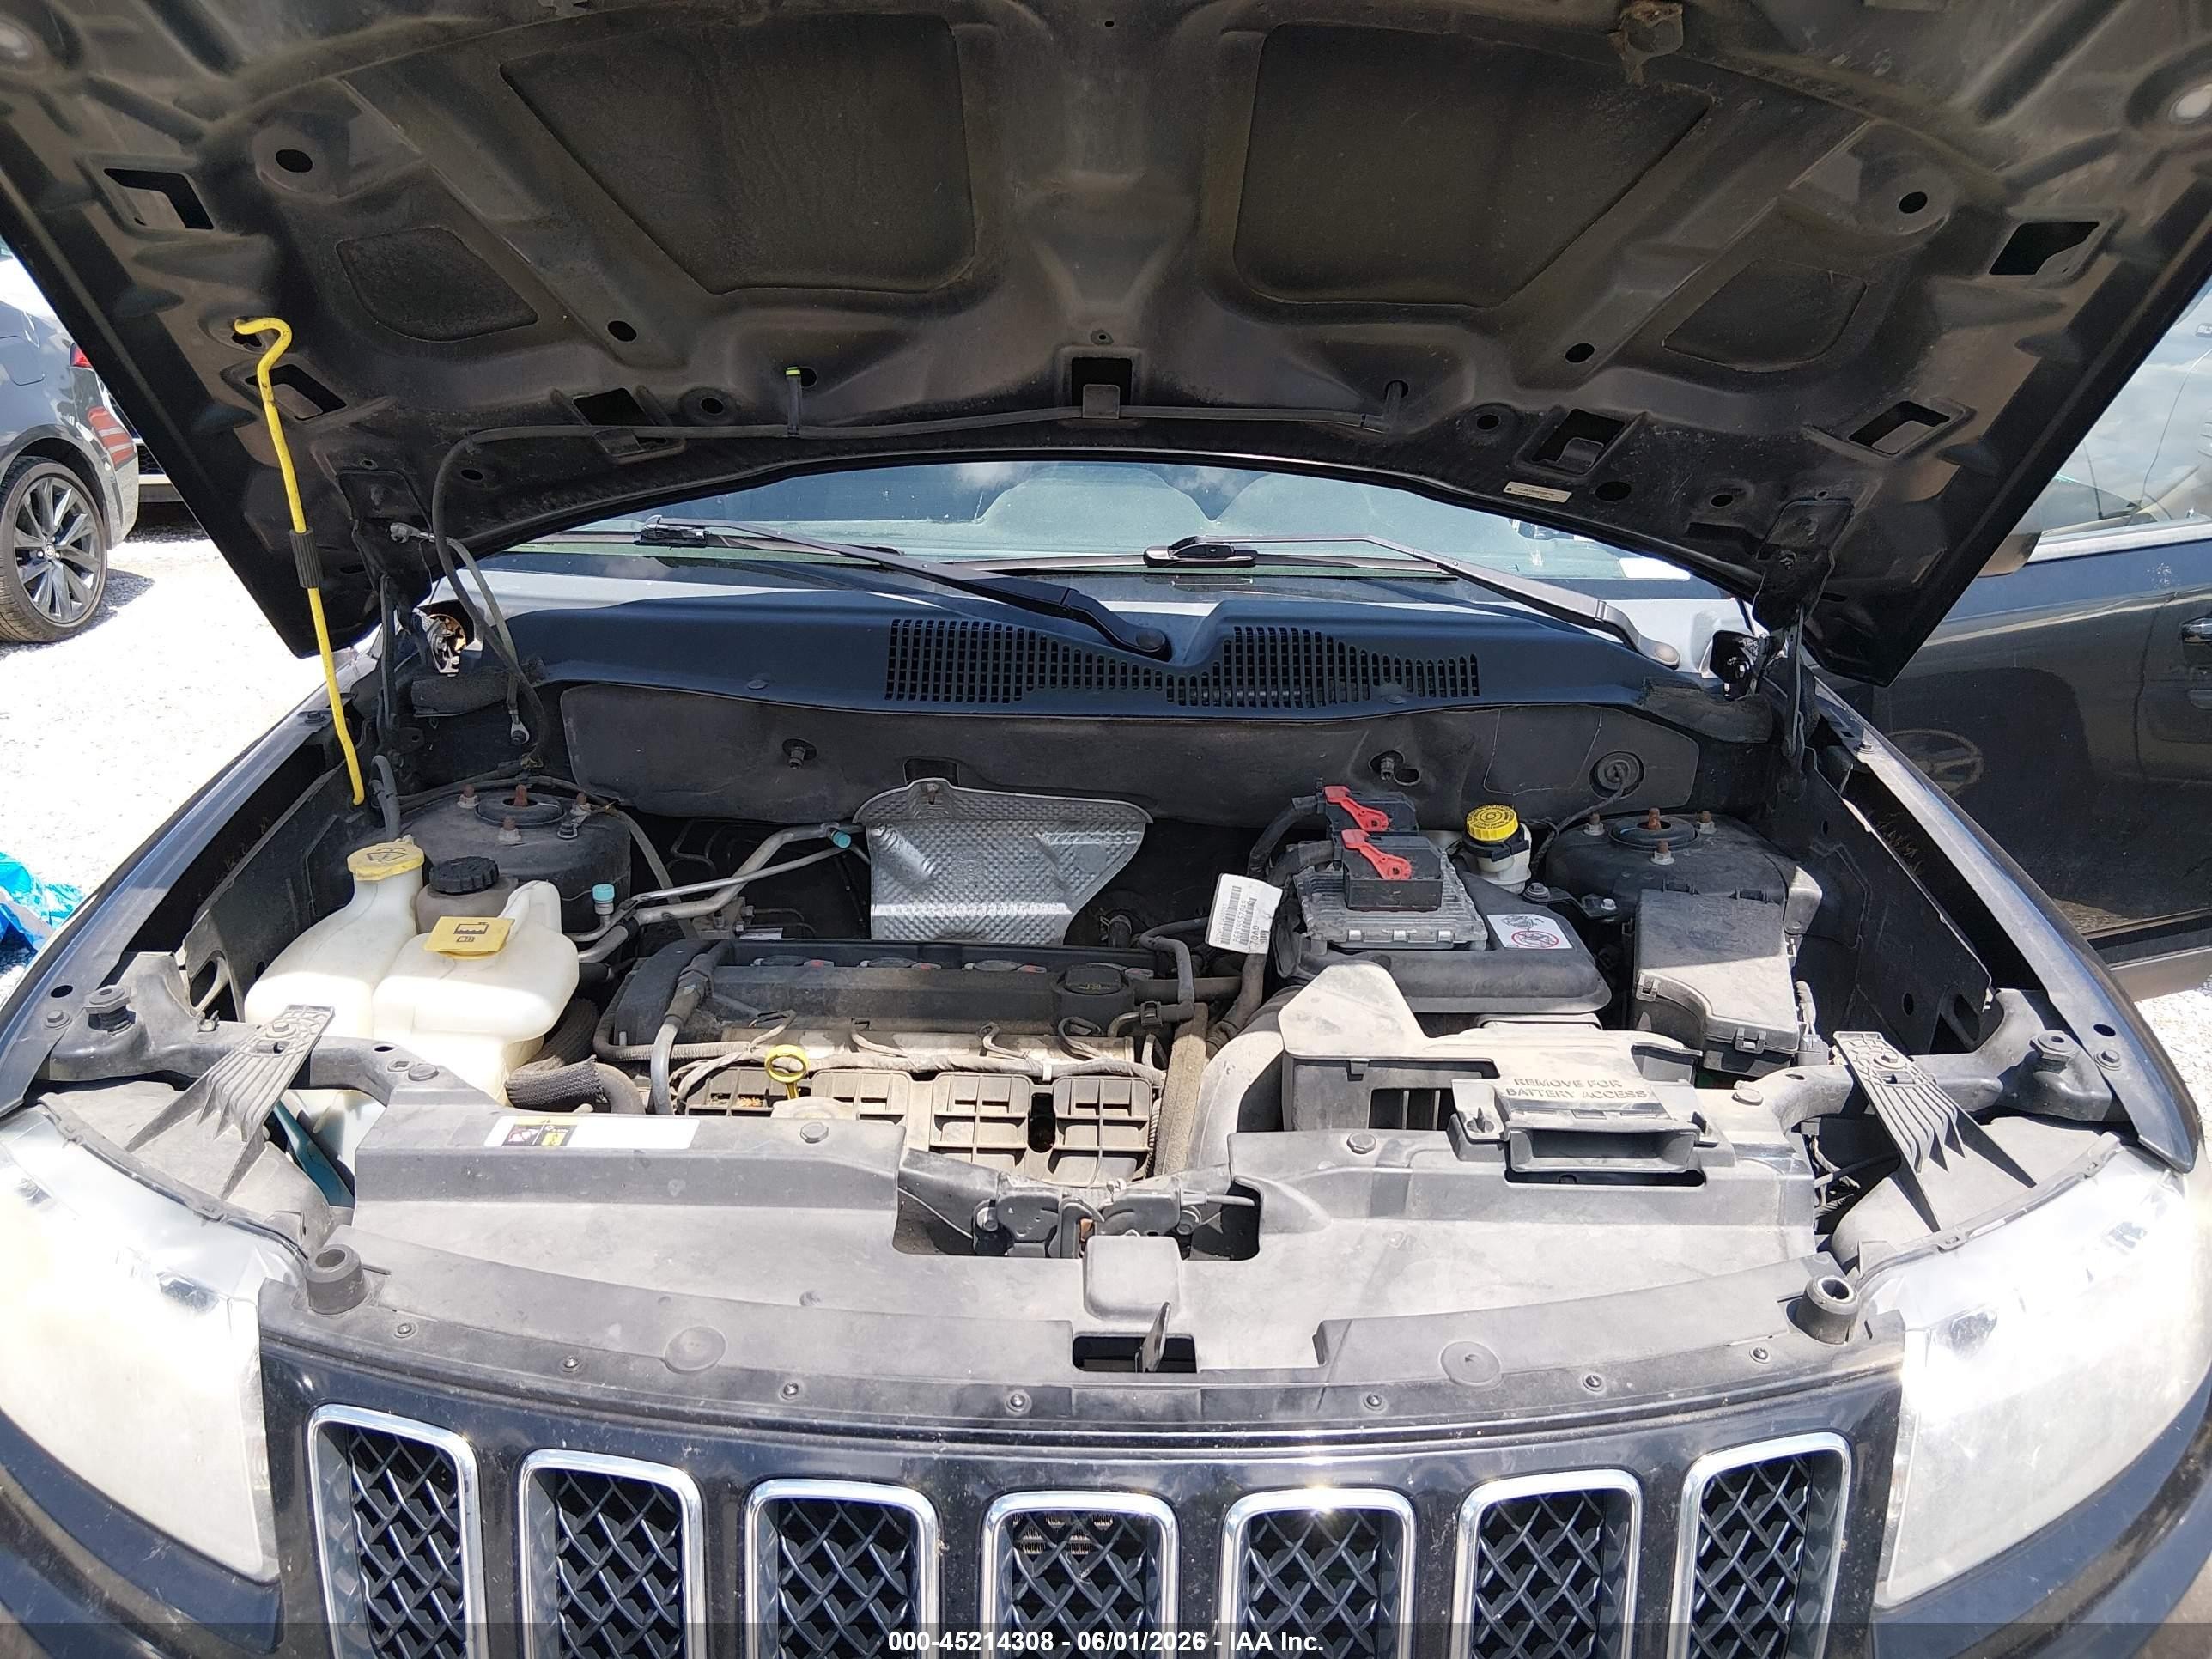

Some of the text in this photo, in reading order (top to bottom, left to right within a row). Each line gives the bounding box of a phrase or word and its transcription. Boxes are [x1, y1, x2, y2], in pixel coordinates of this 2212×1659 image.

[1514, 1078, 1622, 1088] REMOVE FOR
[1505, 1088, 1647, 1099] BATTERY ACCESS
